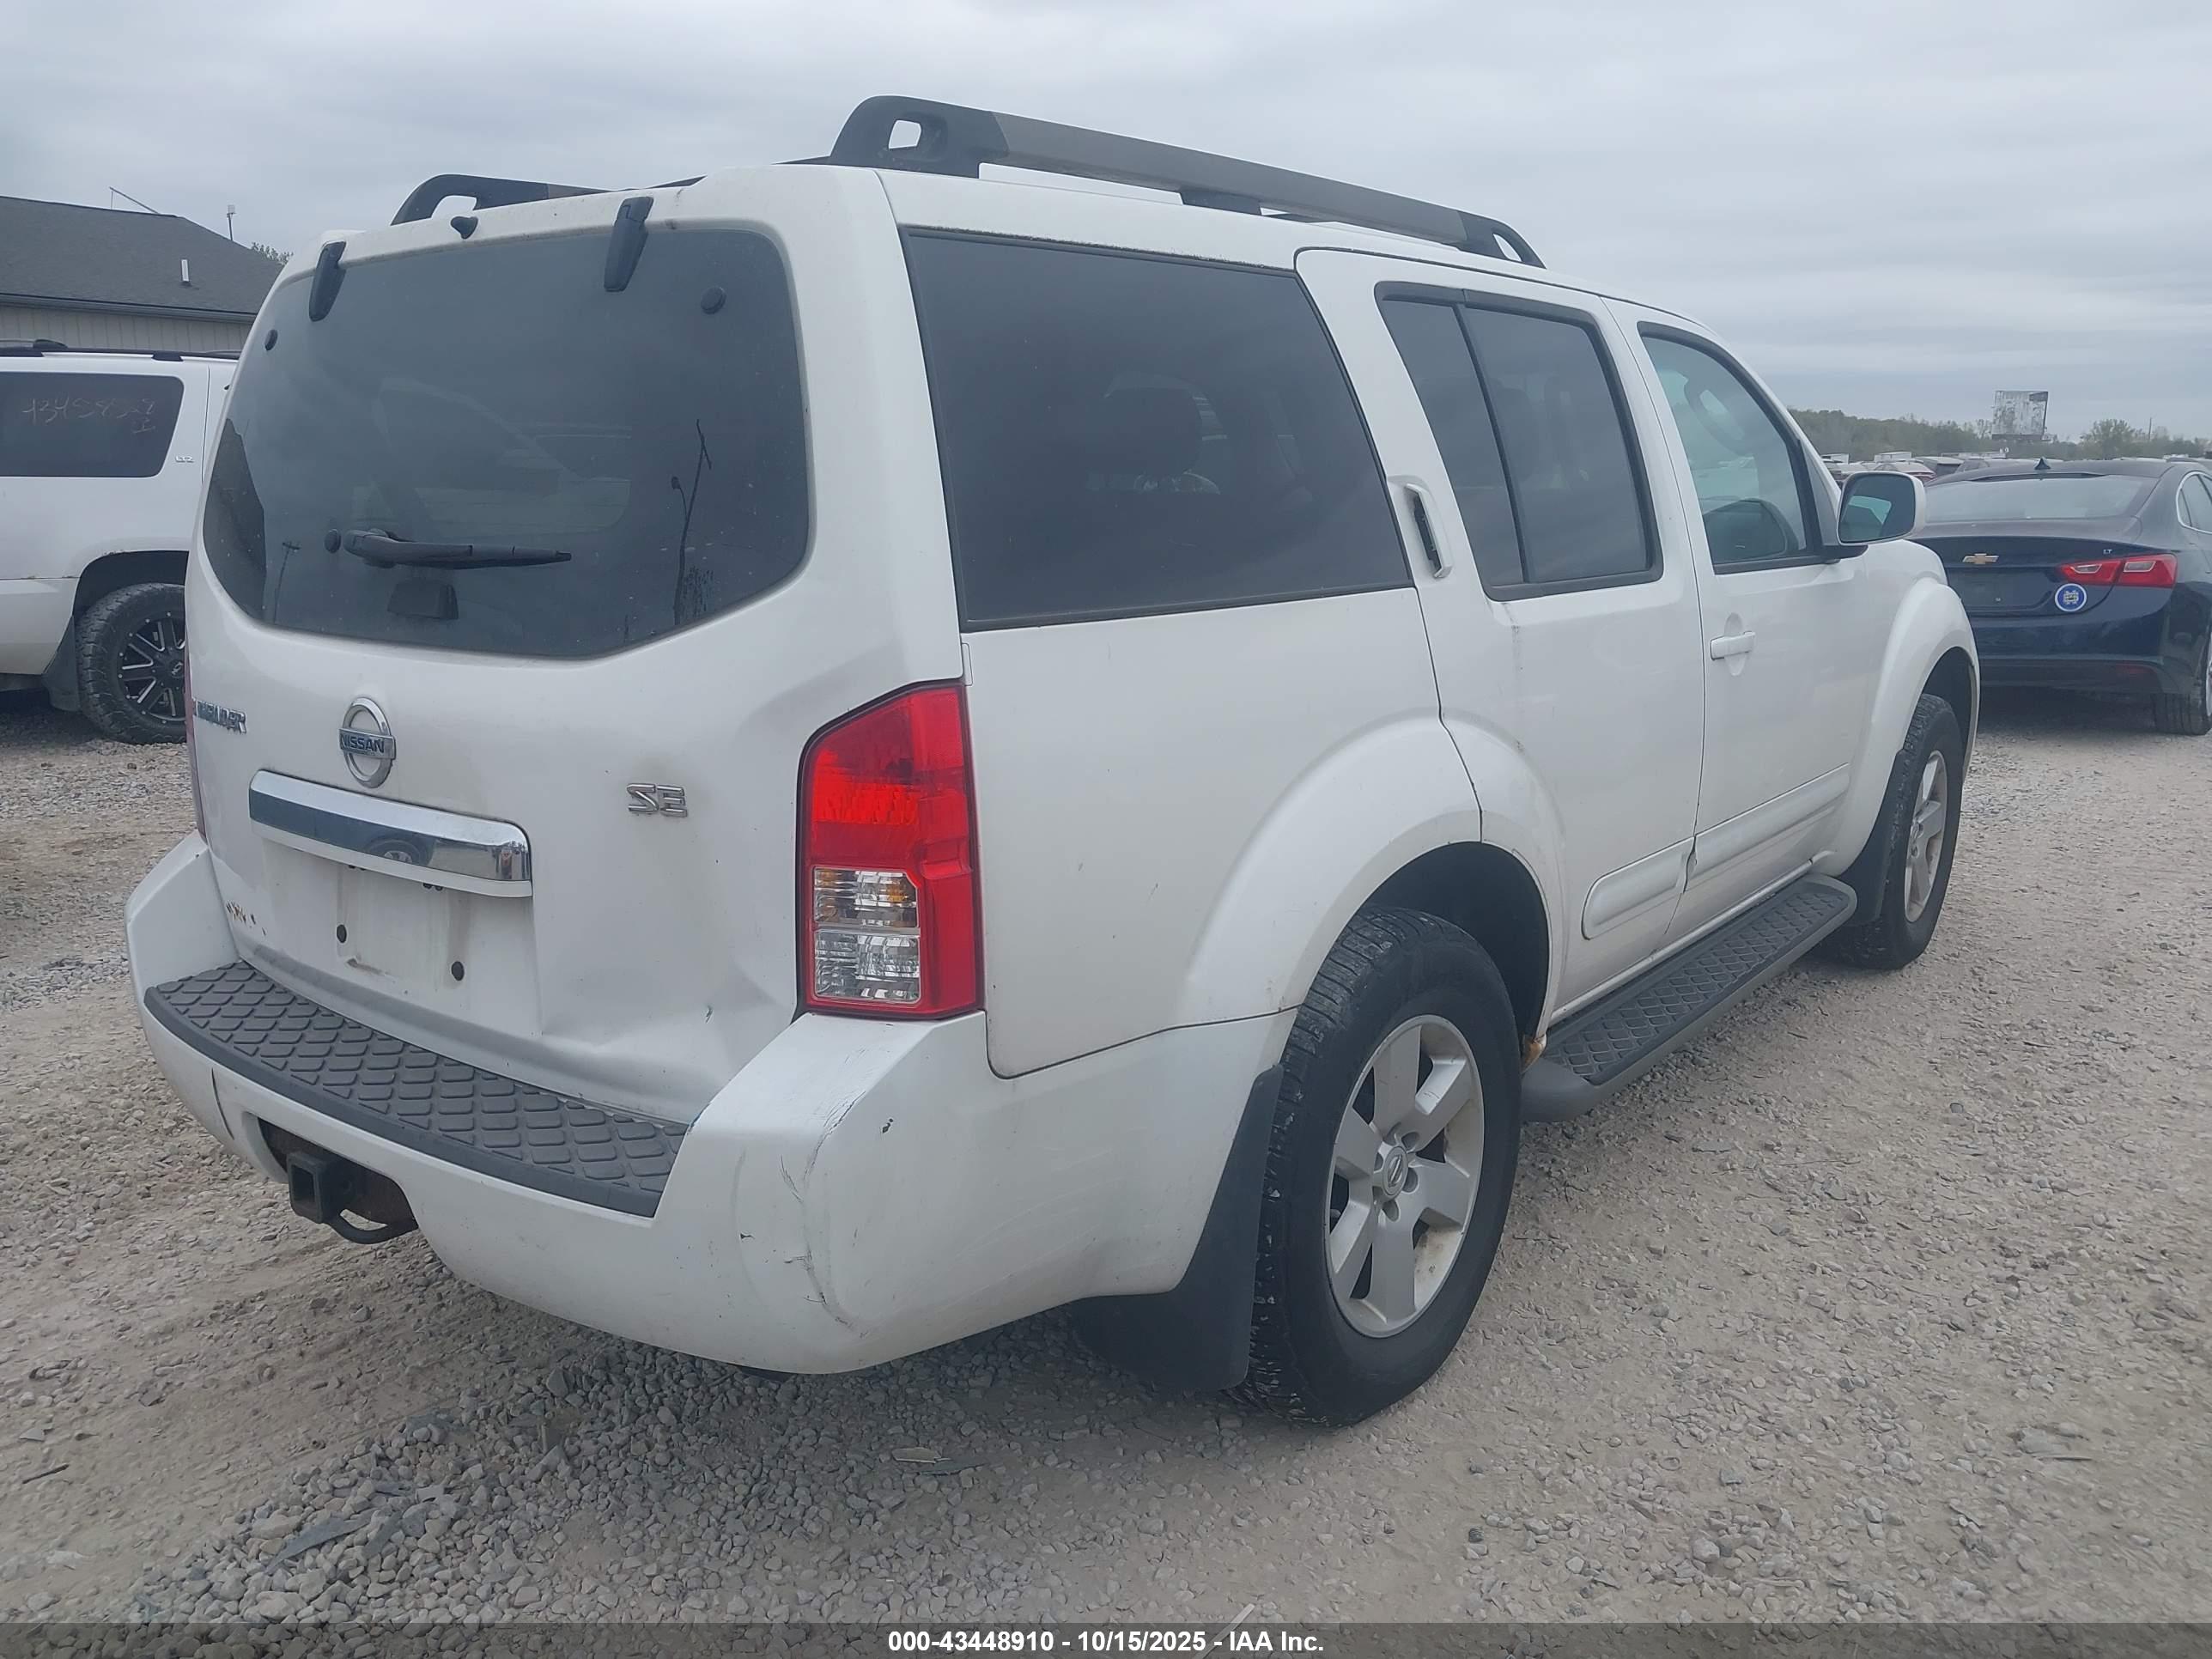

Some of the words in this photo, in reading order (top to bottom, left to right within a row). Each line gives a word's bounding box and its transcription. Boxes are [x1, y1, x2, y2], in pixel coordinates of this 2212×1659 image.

[175, 455, 195, 464] LTZ
[340, 732, 385, 754] NISSAN
[626, 782, 689, 817] SE
